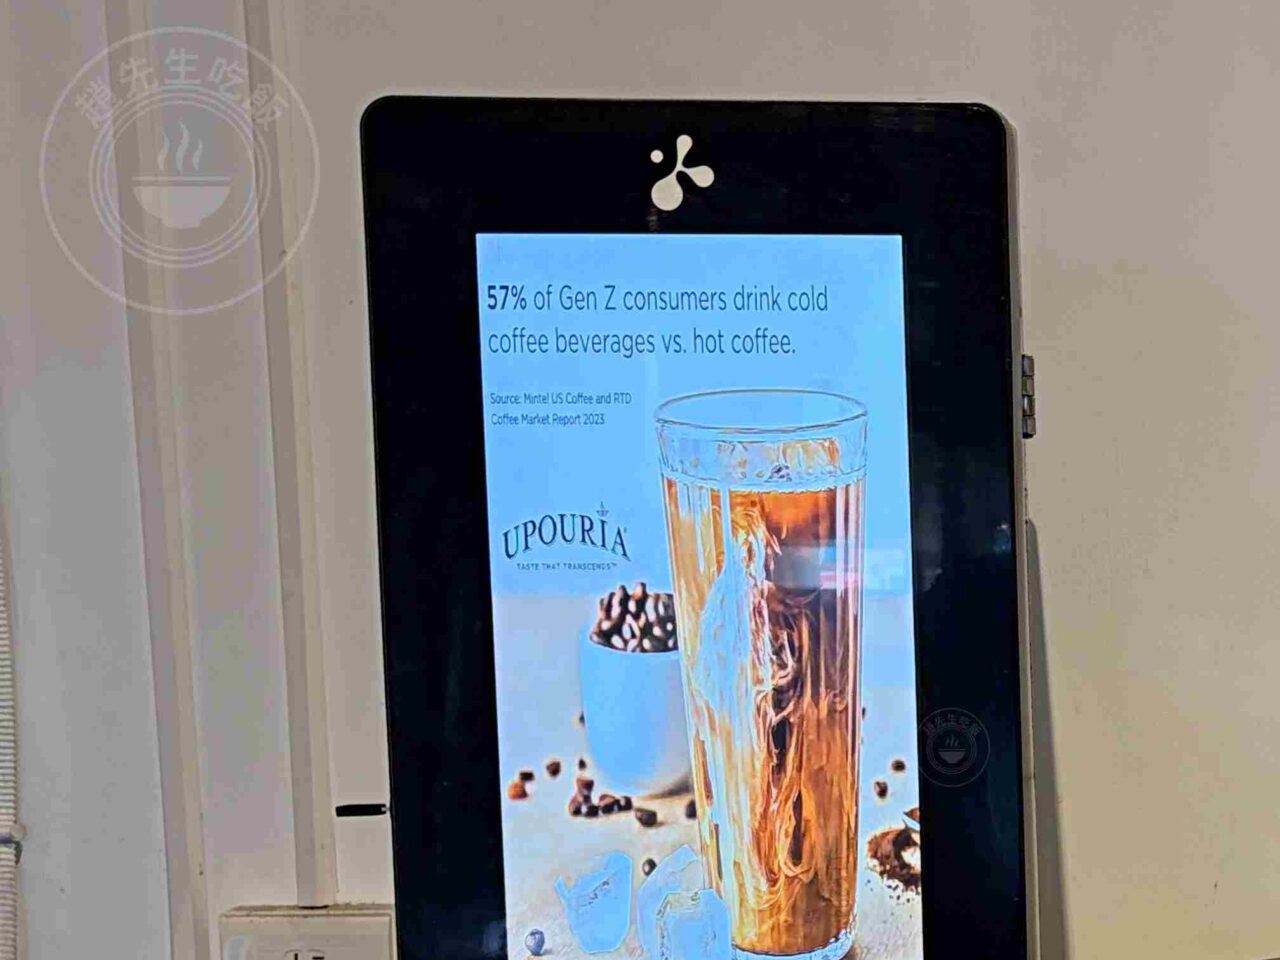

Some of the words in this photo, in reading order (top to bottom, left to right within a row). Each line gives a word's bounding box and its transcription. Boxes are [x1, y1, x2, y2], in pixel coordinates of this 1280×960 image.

[487, 285, 527, 310] 57%
[534, 284, 552, 310] of
[559, 284, 597, 310] Gen
[604, 285, 617, 310] Z
[623, 290, 727, 311] consumers
[733, 284, 782, 311] drink
[788, 285, 828, 311] cold
[488, 327, 549, 353] coffee
[555, 327, 656, 359] beverages
[661, 334, 687, 353] vs.
[693, 327, 725, 353] hot
[731, 327, 796, 354] coffee.
[490, 392, 521, 404] Source:
[524, 392, 549, 404] Mintel
[551, 392, 564, 404] US
[565, 392, 593, 404] Coffee
[596, 392, 612, 404] and
[614, 392, 632, 404] RTD
[491, 413, 519, 425] Coffee
[521, 413, 550, 425] Market
[552, 413, 581, 427] Report
[583, 413, 605, 425] 2023
[516, 562, 540, 571] TASTE
[541, 562, 561, 571] THAT
